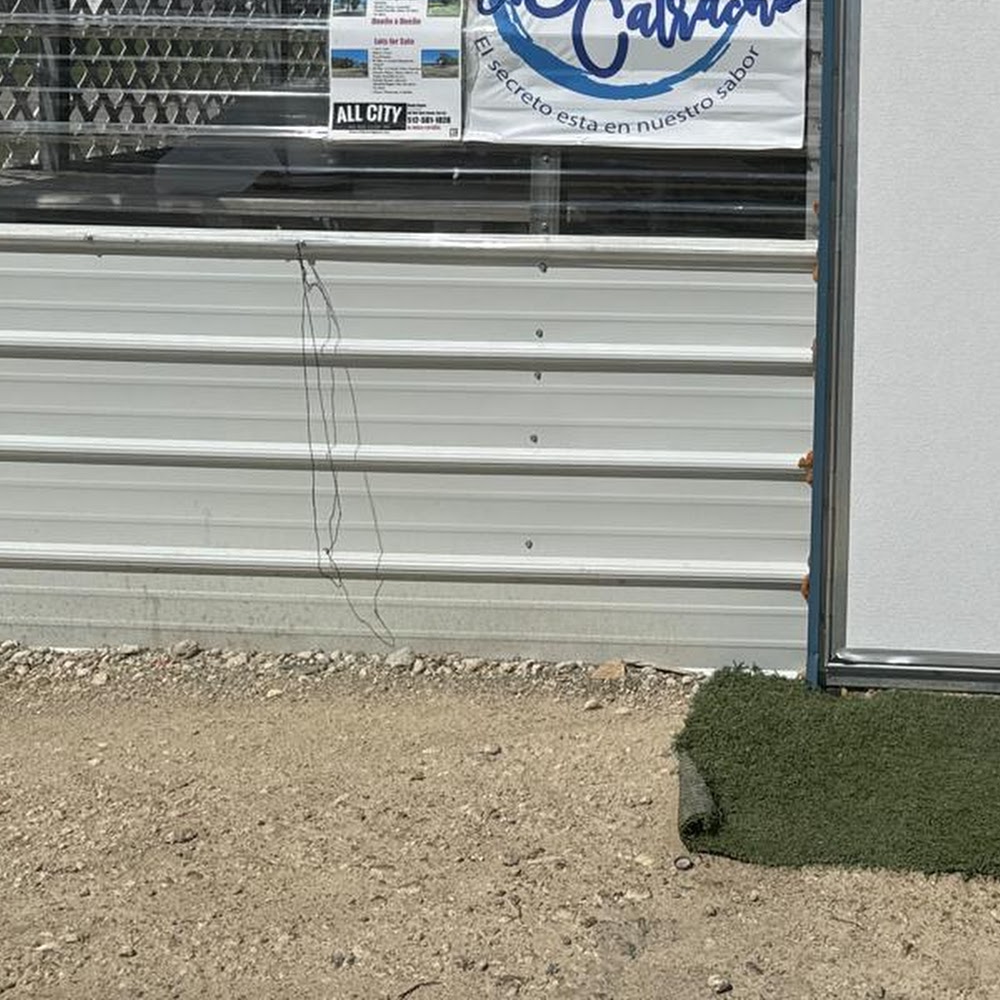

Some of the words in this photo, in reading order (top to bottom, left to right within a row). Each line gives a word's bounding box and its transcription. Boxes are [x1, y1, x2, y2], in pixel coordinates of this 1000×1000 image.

[337, 104, 363, 123] ALL
[367, 104, 402, 123] CITY
[473, 35, 494, 57] El
[487, 59, 552, 117] secreto
[556, 110, 599, 132] esta
[604, 121, 631, 134] en
[637, 96, 714, 133] nuestro
[716, 44, 761, 100] sabor
